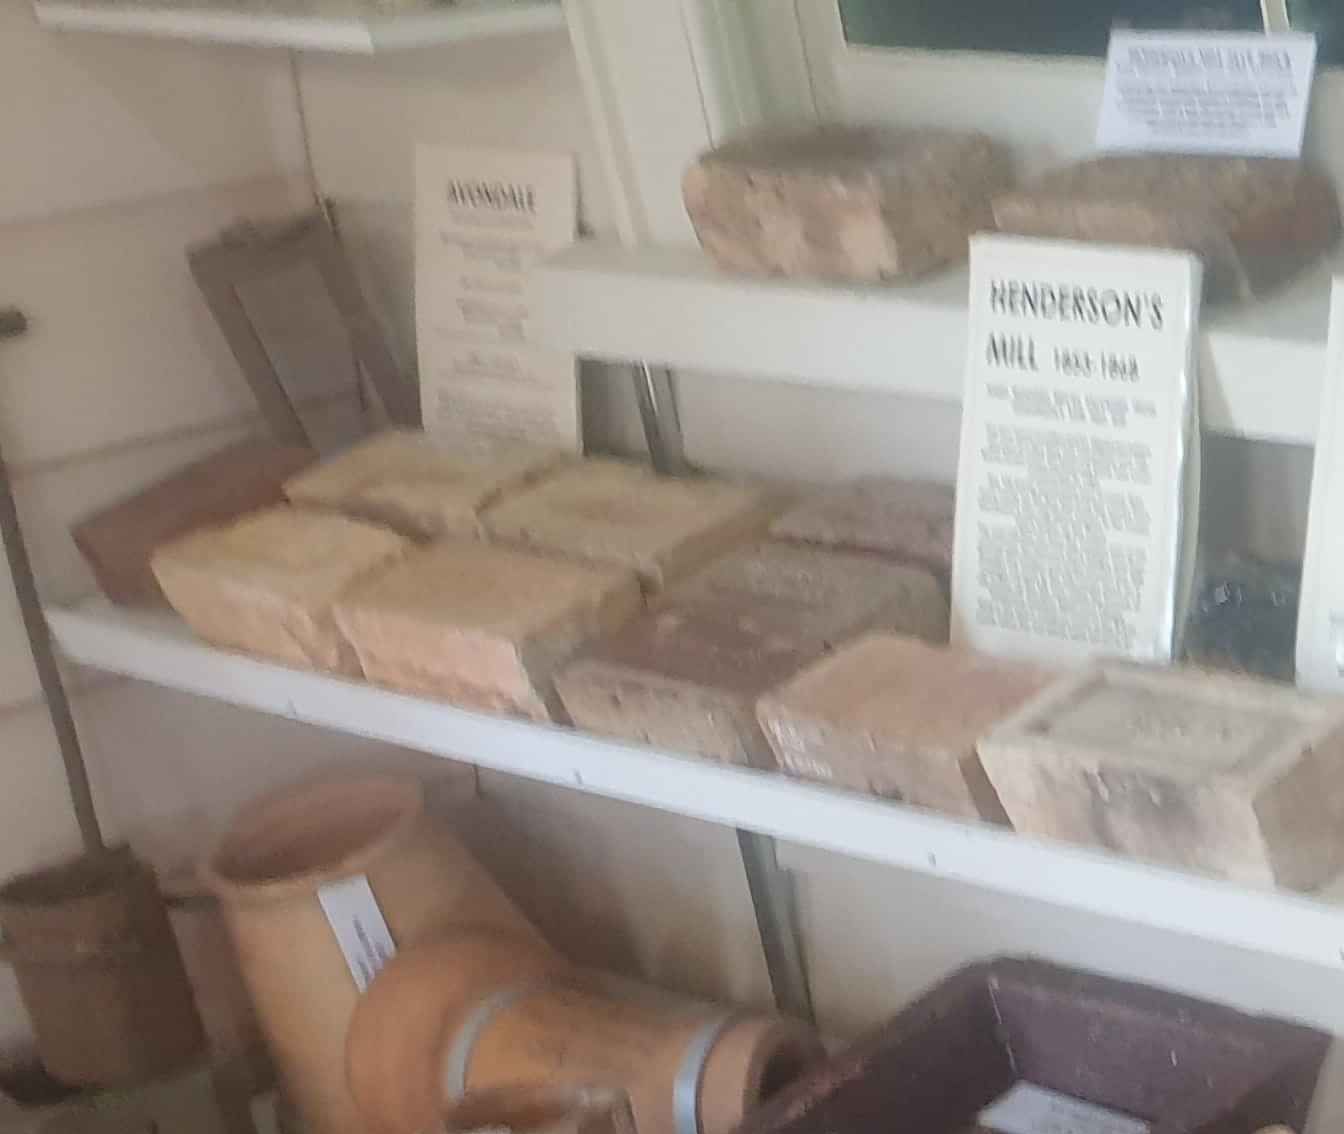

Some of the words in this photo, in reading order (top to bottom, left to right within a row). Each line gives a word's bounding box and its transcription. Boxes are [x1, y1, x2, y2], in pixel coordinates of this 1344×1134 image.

[448, 178, 535, 213] AVONDALE
[988, 279, 1164, 331] HENDERSON'S
[986, 331, 1038, 373] MILL
